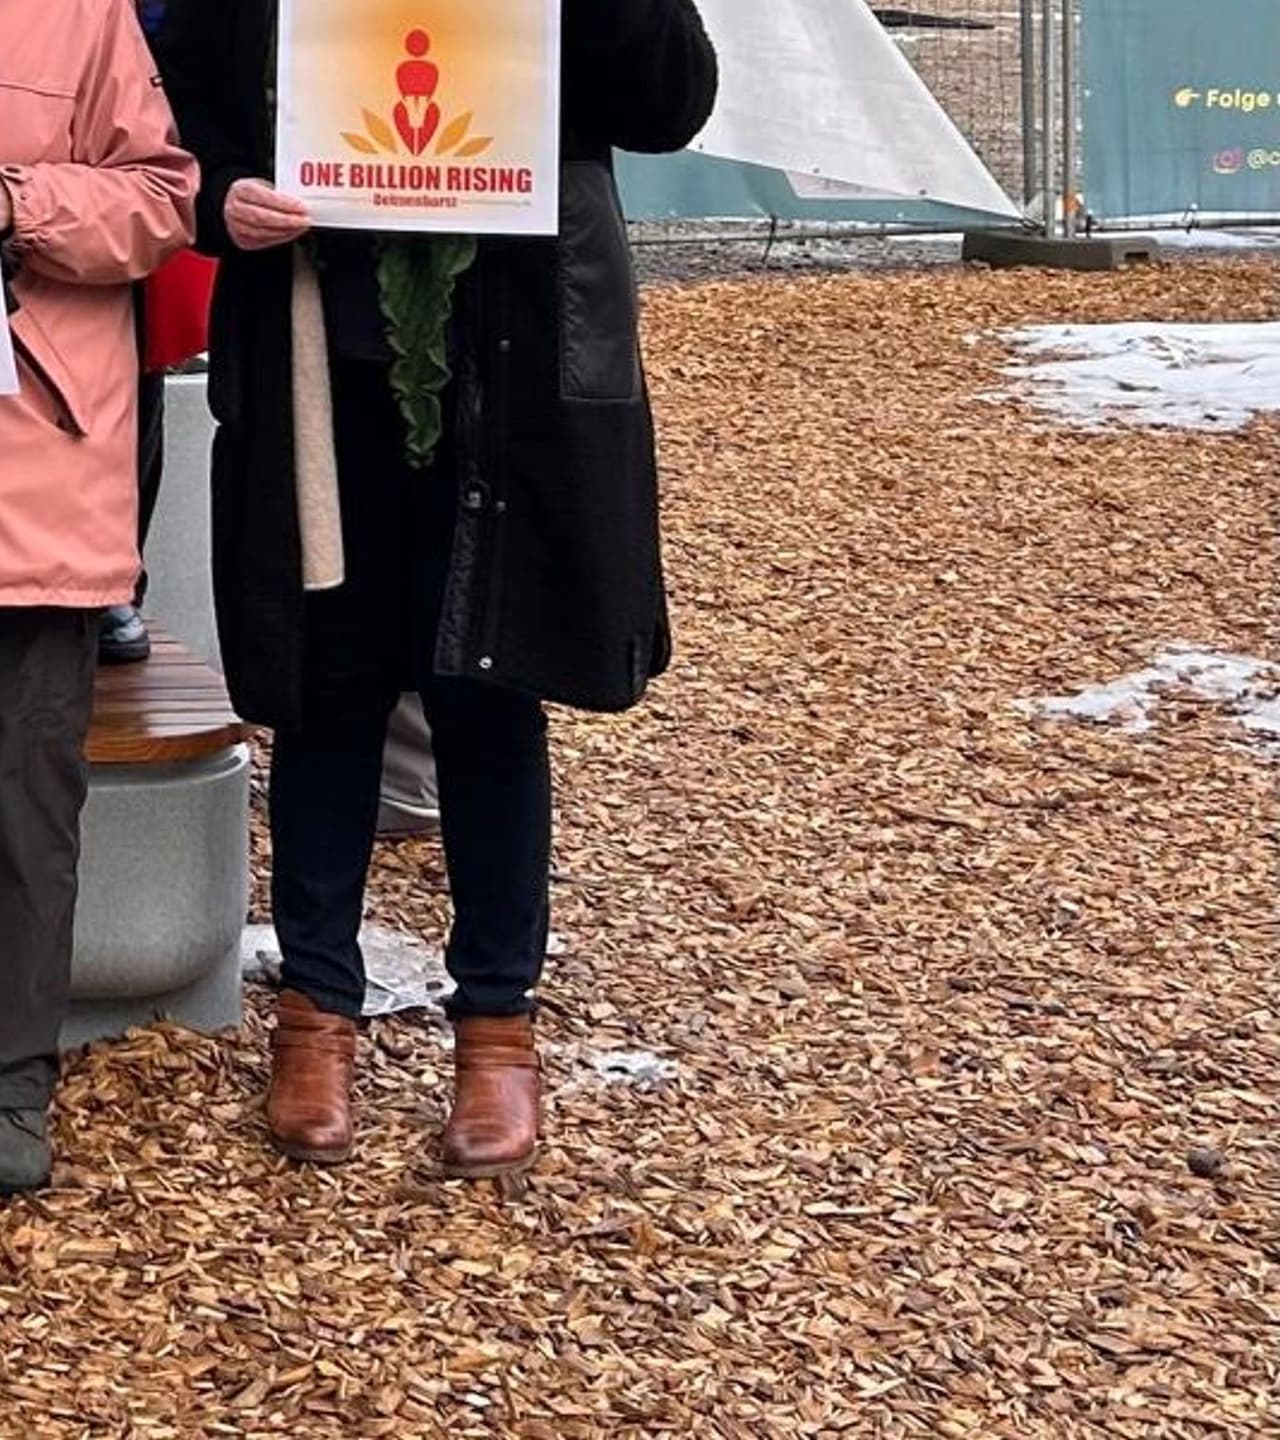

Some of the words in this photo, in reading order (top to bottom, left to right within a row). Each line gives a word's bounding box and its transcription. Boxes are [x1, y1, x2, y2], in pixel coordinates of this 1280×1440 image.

[1206, 88, 1270, 112] Folge
[300, 161, 345, 187] ONE
[349, 162, 440, 190] BILLION
[447, 168, 533, 193] RISING
